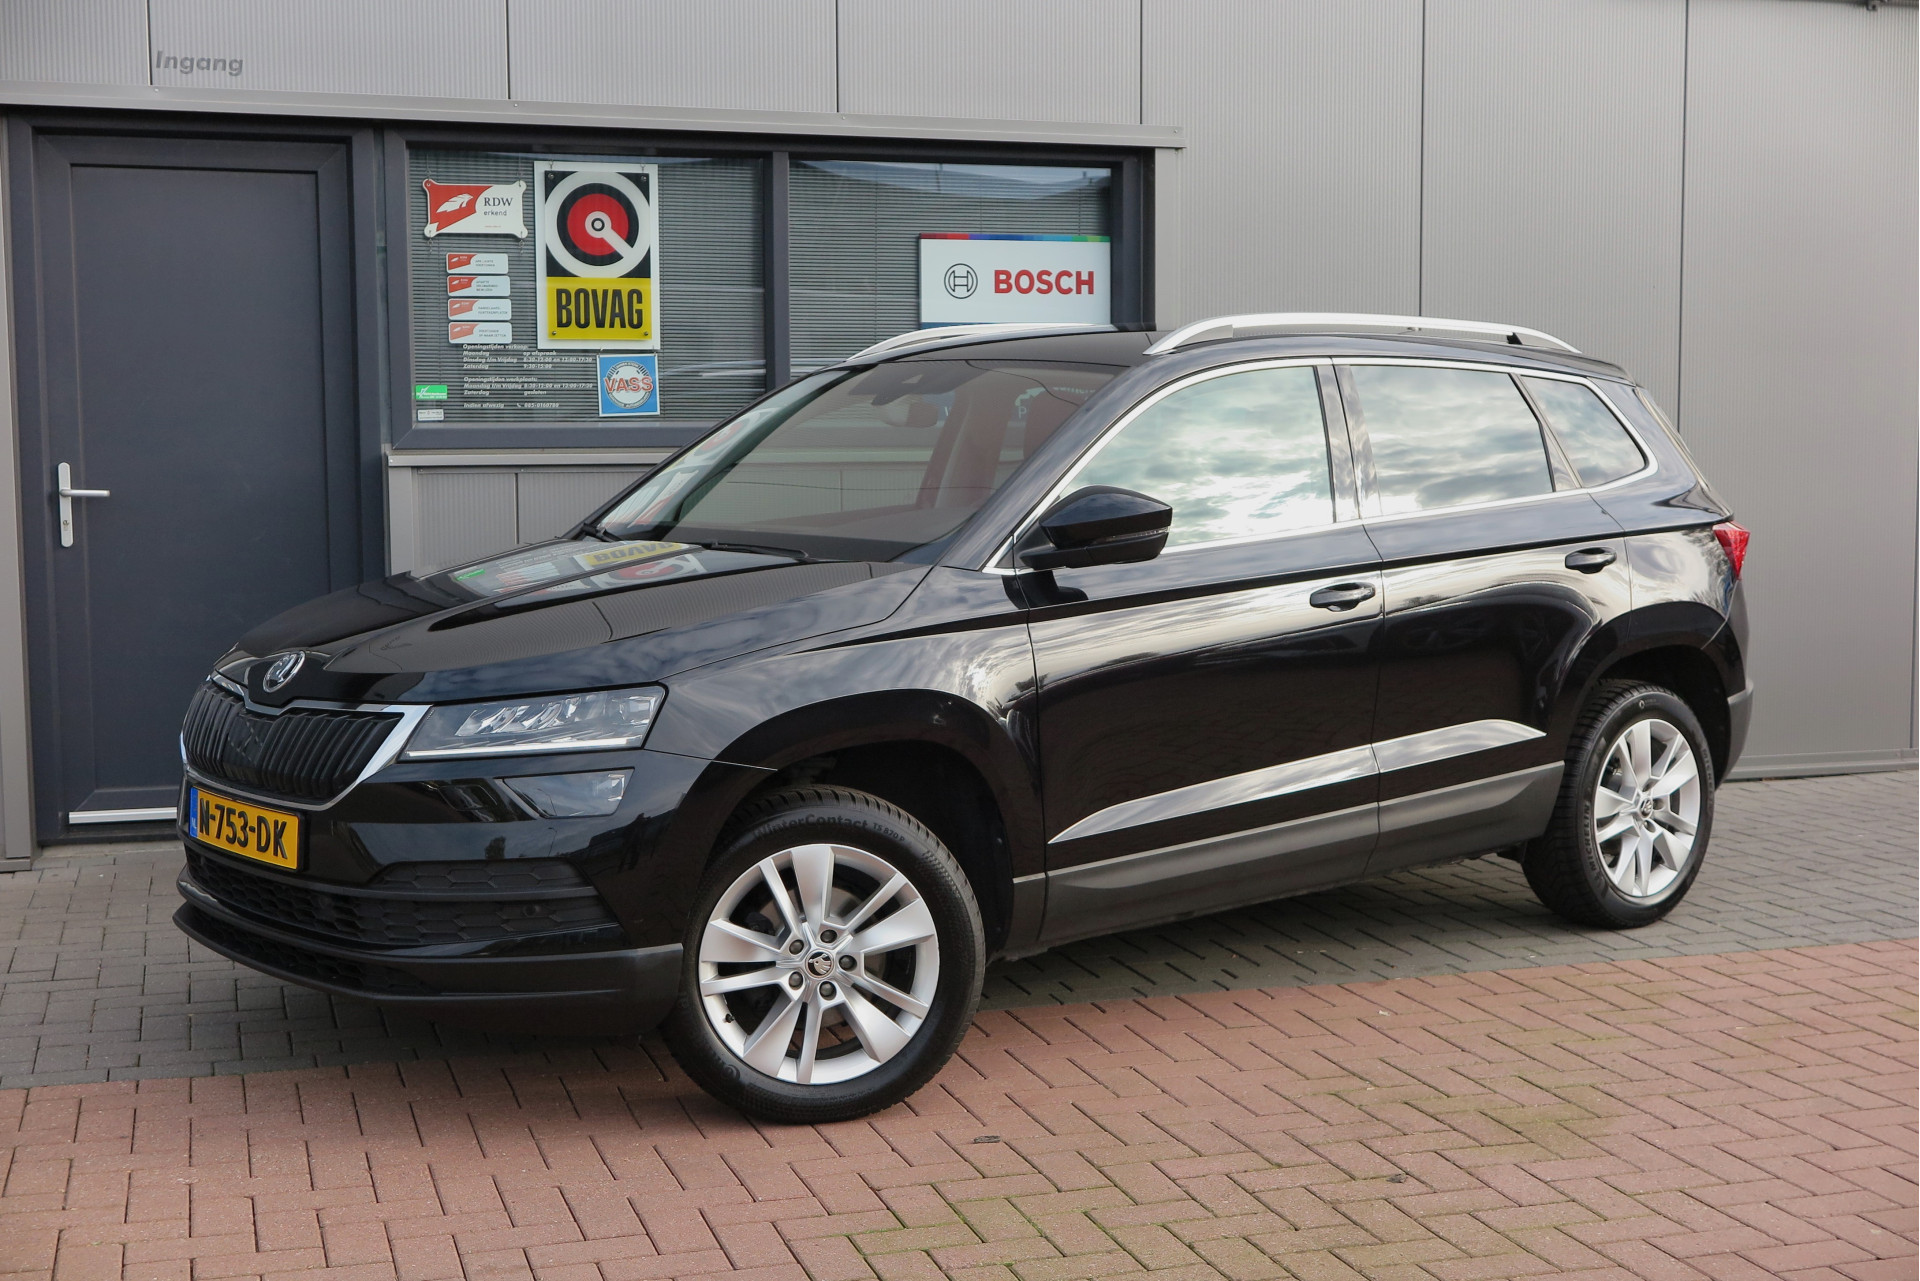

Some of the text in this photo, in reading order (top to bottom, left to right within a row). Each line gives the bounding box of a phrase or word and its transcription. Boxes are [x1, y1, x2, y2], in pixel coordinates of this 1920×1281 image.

[156, 50, 243, 76] Ingang
[484, 197, 513, 207] RDW
[994, 269, 1094, 295] BOSCH
[556, 288, 643, 329] BOVAG
[604, 376, 653, 392] VASS
[200, 798, 288, 859] N-753-DK
[753, 813, 868, 840] WinterContact
[873, 822, 885, 832] TS
[884, 826, 899, 839] 870
[1584, 800, 1598, 872] MICHELIN
